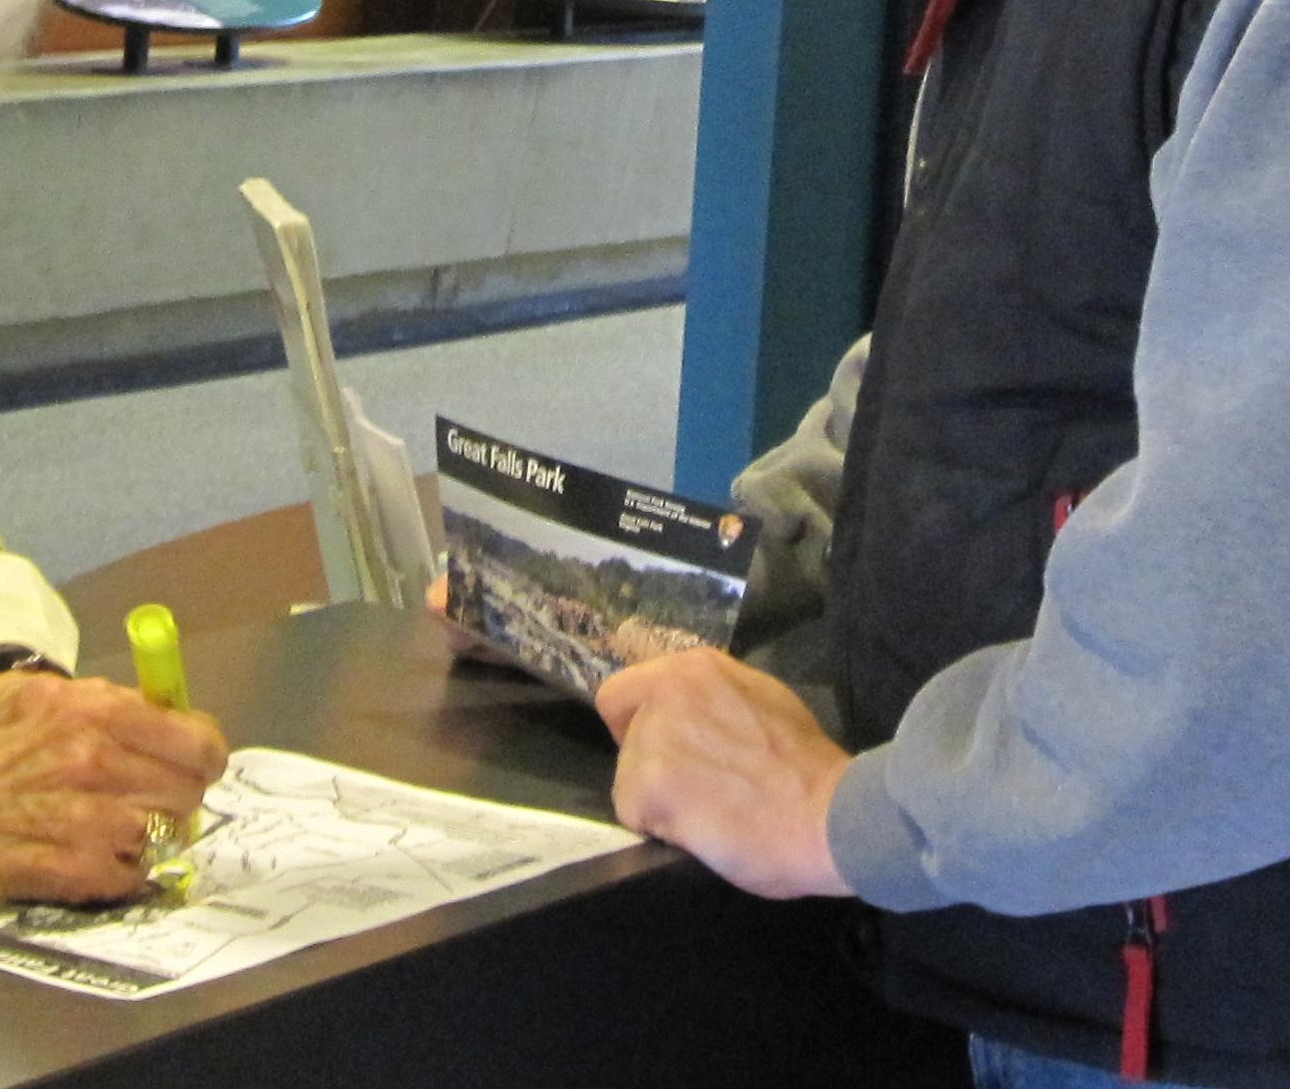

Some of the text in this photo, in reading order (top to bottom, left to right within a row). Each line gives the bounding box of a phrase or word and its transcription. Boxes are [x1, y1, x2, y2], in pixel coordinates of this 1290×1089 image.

[447, 427, 567, 495] Great Falls Park
